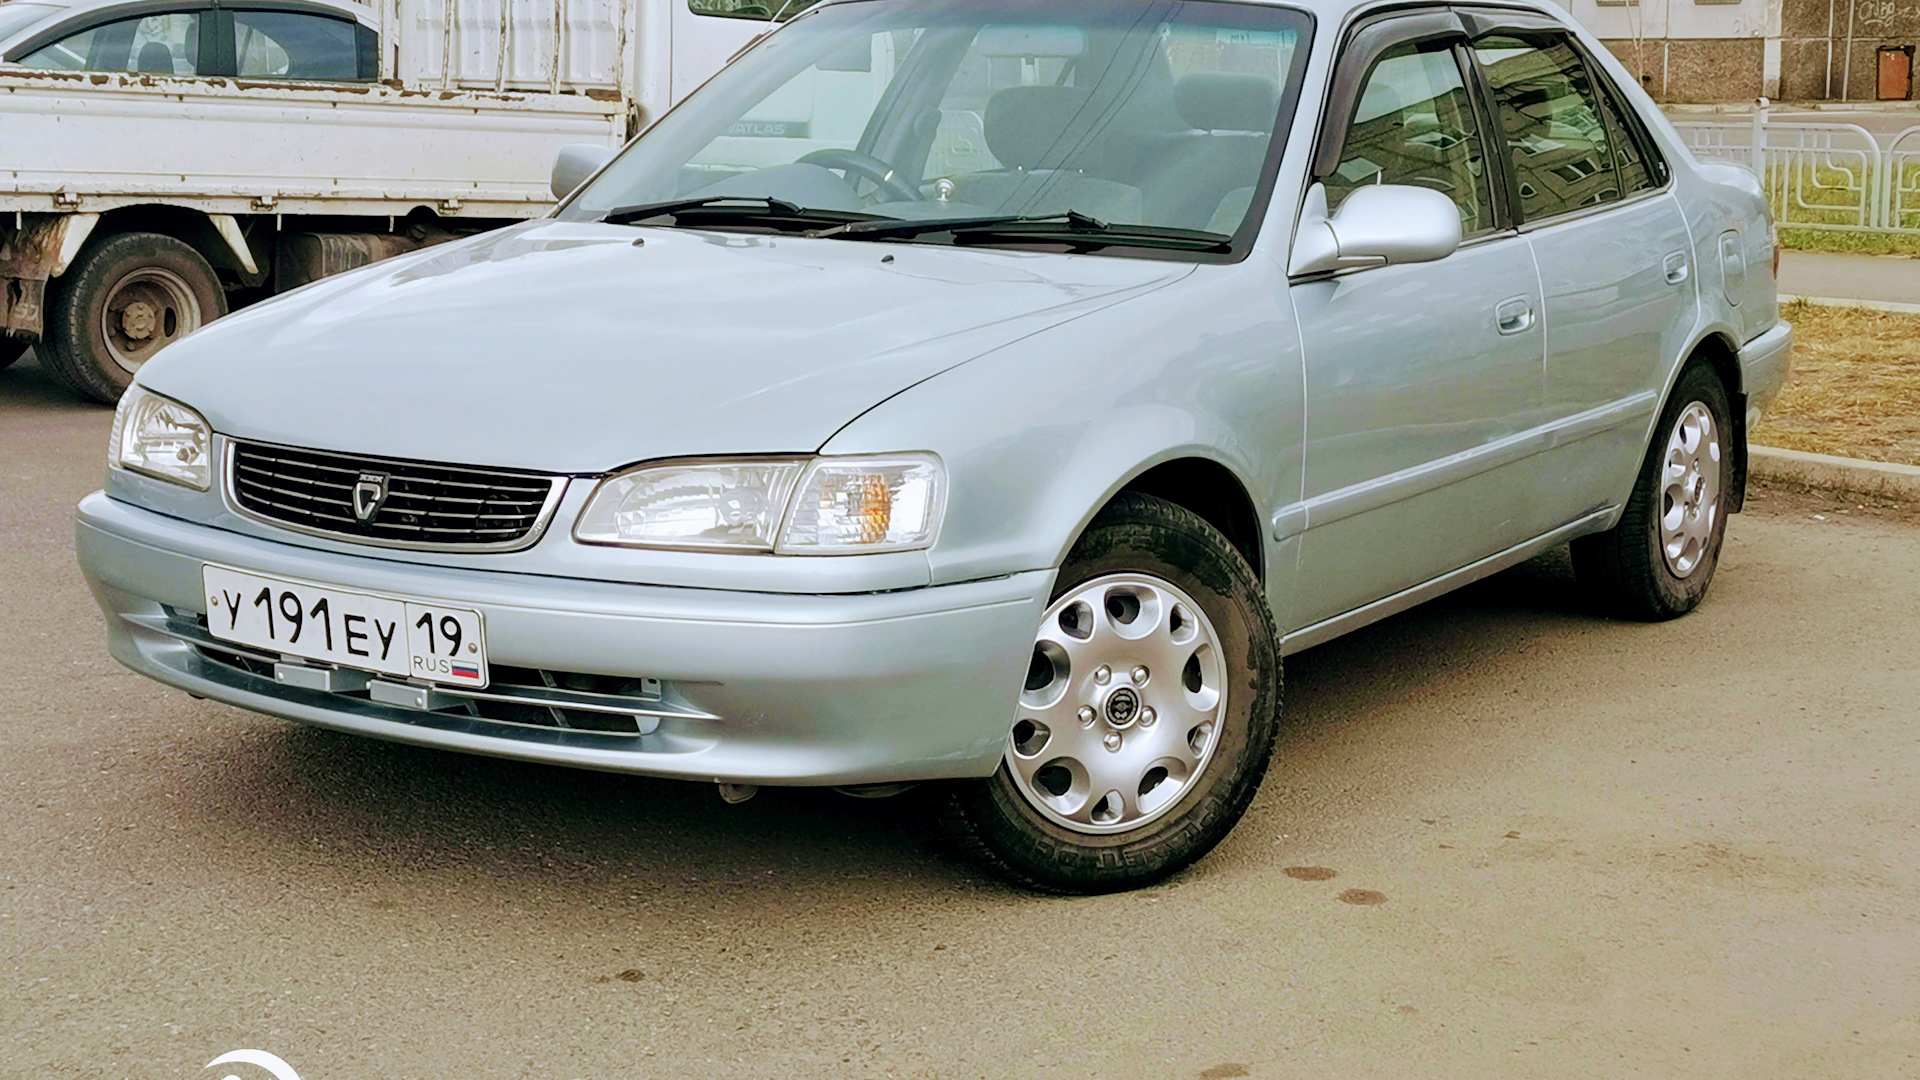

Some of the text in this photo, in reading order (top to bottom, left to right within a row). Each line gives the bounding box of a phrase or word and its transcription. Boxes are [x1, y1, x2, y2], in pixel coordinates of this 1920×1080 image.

[735, 123, 786, 135] ATLAS
[415, 612, 462, 657] 19
[413, 655, 450, 674] RUS
